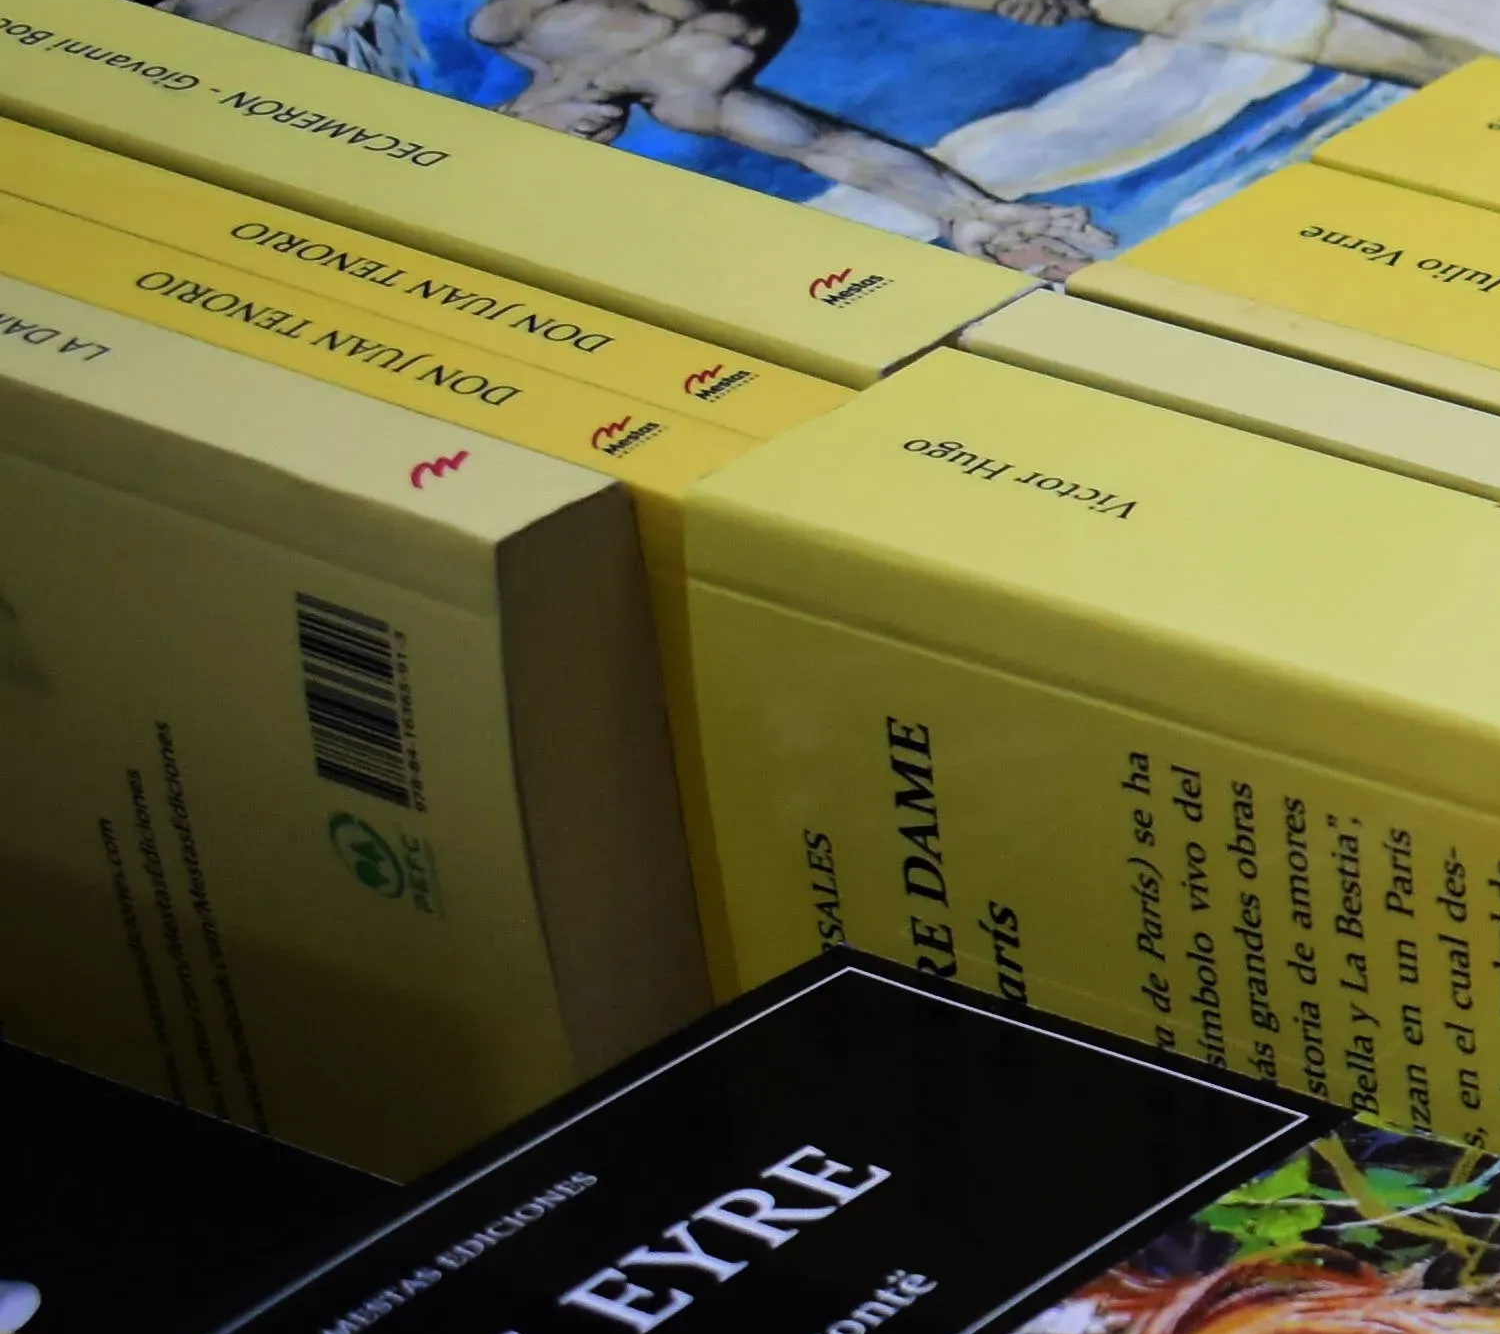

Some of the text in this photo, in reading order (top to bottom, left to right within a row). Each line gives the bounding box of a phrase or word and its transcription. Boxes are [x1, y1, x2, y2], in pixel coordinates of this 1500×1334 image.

[44, 37, 200, 90] Giovanni
[219, 90, 450, 167] DECAMERÓN
[229, 222, 614, 352] DON JUAN TENORIO
[820, 272, 885, 307] Mestas
[1299, 225, 1403, 266] Verne
[0, 312, 111, 361] LA DA
[134, 271, 522, 406] DON JUAN TENORIO
[902, 438, 1137, 519] Victor Hugo
[885, 715, 949, 907] DAME
[802, 831, 850, 953] SALES
[1327, 813, 1380, 1116] Bella y La Bestia”,
[436, 1171, 598, 1268] EDICIONES
[559, 1144, 890, 1333] EYRE
